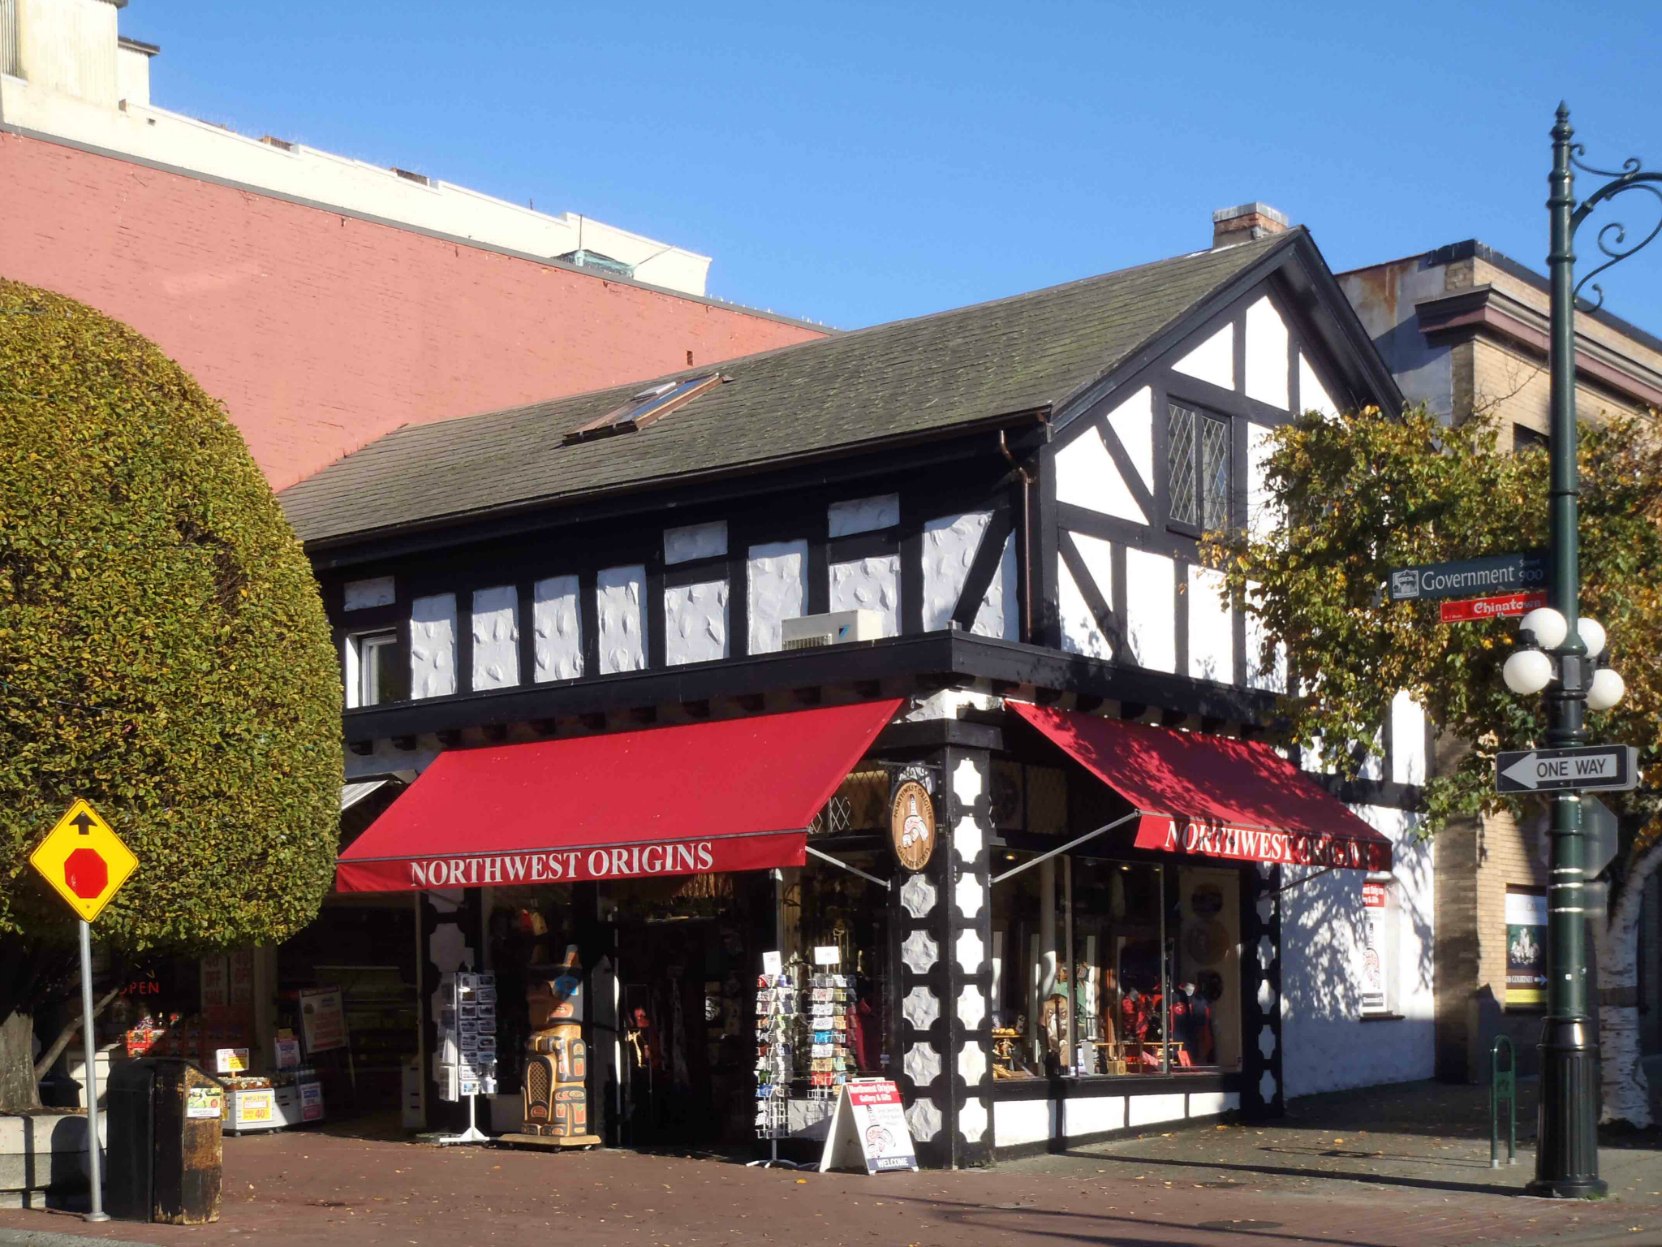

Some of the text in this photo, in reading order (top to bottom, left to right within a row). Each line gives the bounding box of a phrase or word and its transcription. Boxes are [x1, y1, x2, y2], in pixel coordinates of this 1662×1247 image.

[1421, 565, 1515, 591] Government
[1519, 569, 1544, 583] 900
[1473, 599, 1542, 614] Chinatown
[1536, 758, 1607, 778] ONE WAY
[1165, 820, 1293, 861] NORTHWEST
[410, 841, 714, 887] NORTHWEST ORIGINS
[876, 1157, 909, 1168] WELCOME
